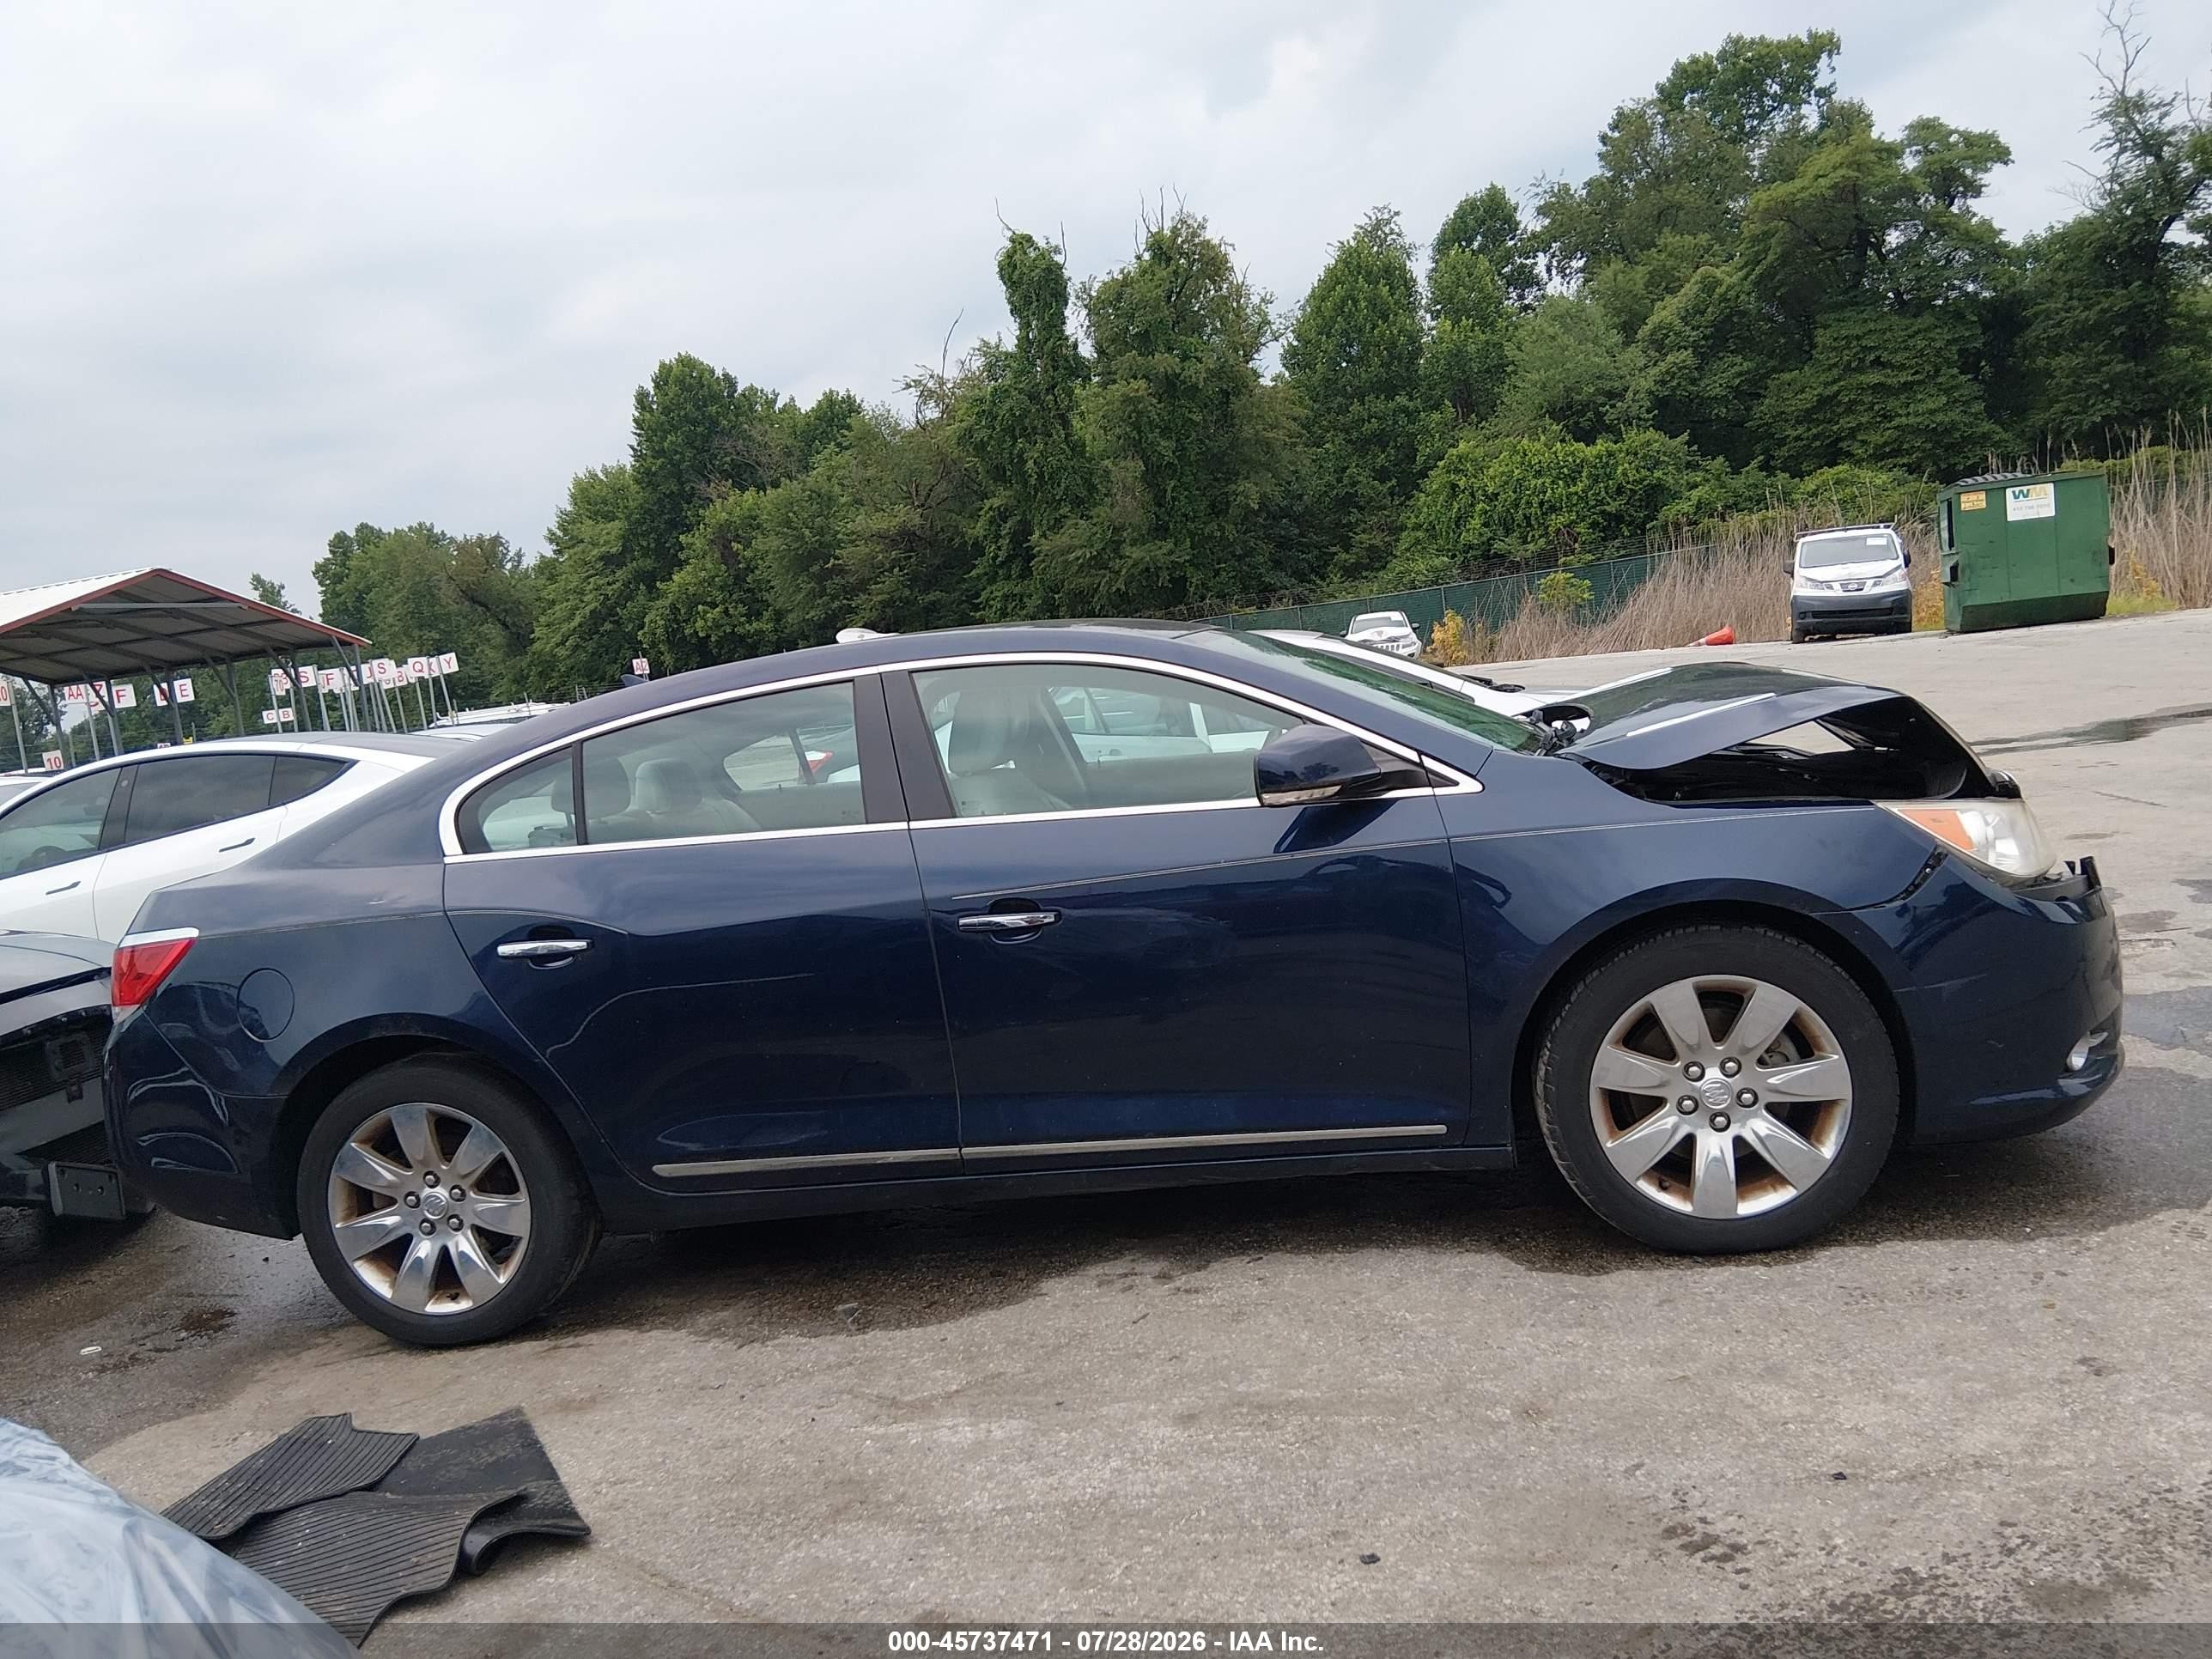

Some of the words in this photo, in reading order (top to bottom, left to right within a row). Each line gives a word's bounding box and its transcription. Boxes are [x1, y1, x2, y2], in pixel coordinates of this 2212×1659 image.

[2012, 486, 2048, 500] WM
[377, 662, 386, 675] S
[412, 661, 424, 673] Q
[443, 657, 452, 669] Y
[325, 672, 334, 685] F
[68, 685, 84, 700] AA
[116, 689, 126, 703] F
[179, 684, 189, 698] E
[47, 756, 62, 769] 10
